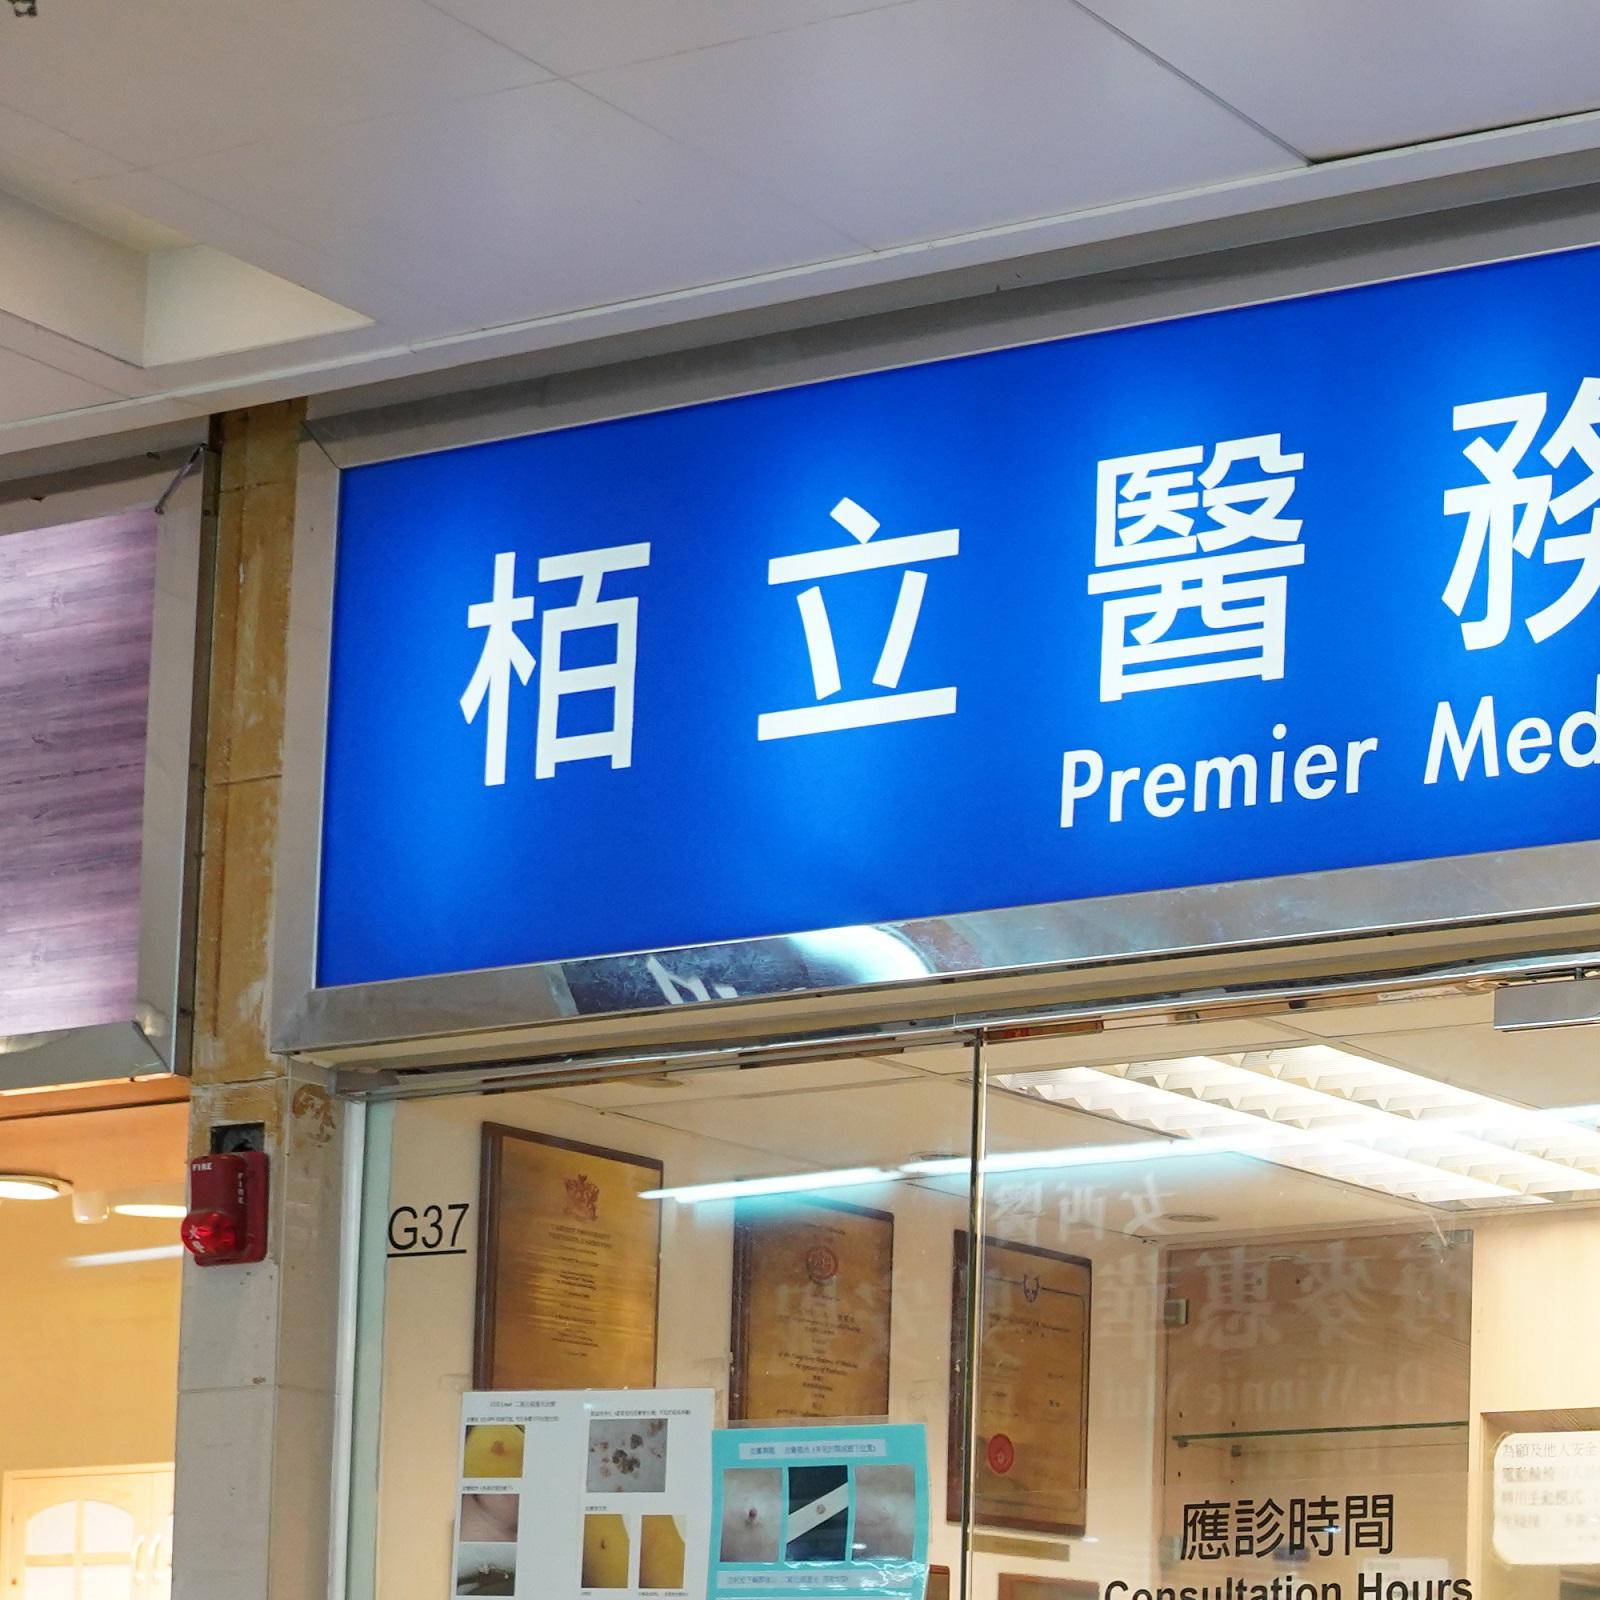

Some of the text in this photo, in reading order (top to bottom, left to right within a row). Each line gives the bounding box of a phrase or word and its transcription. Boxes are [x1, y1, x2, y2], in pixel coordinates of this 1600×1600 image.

[1060, 724, 1378, 828] Premier
[192, 1162, 212, 1171] FIRE
[387, 1203, 468, 1251] G37
[1180, 1494, 1395, 1560] 應診時間
